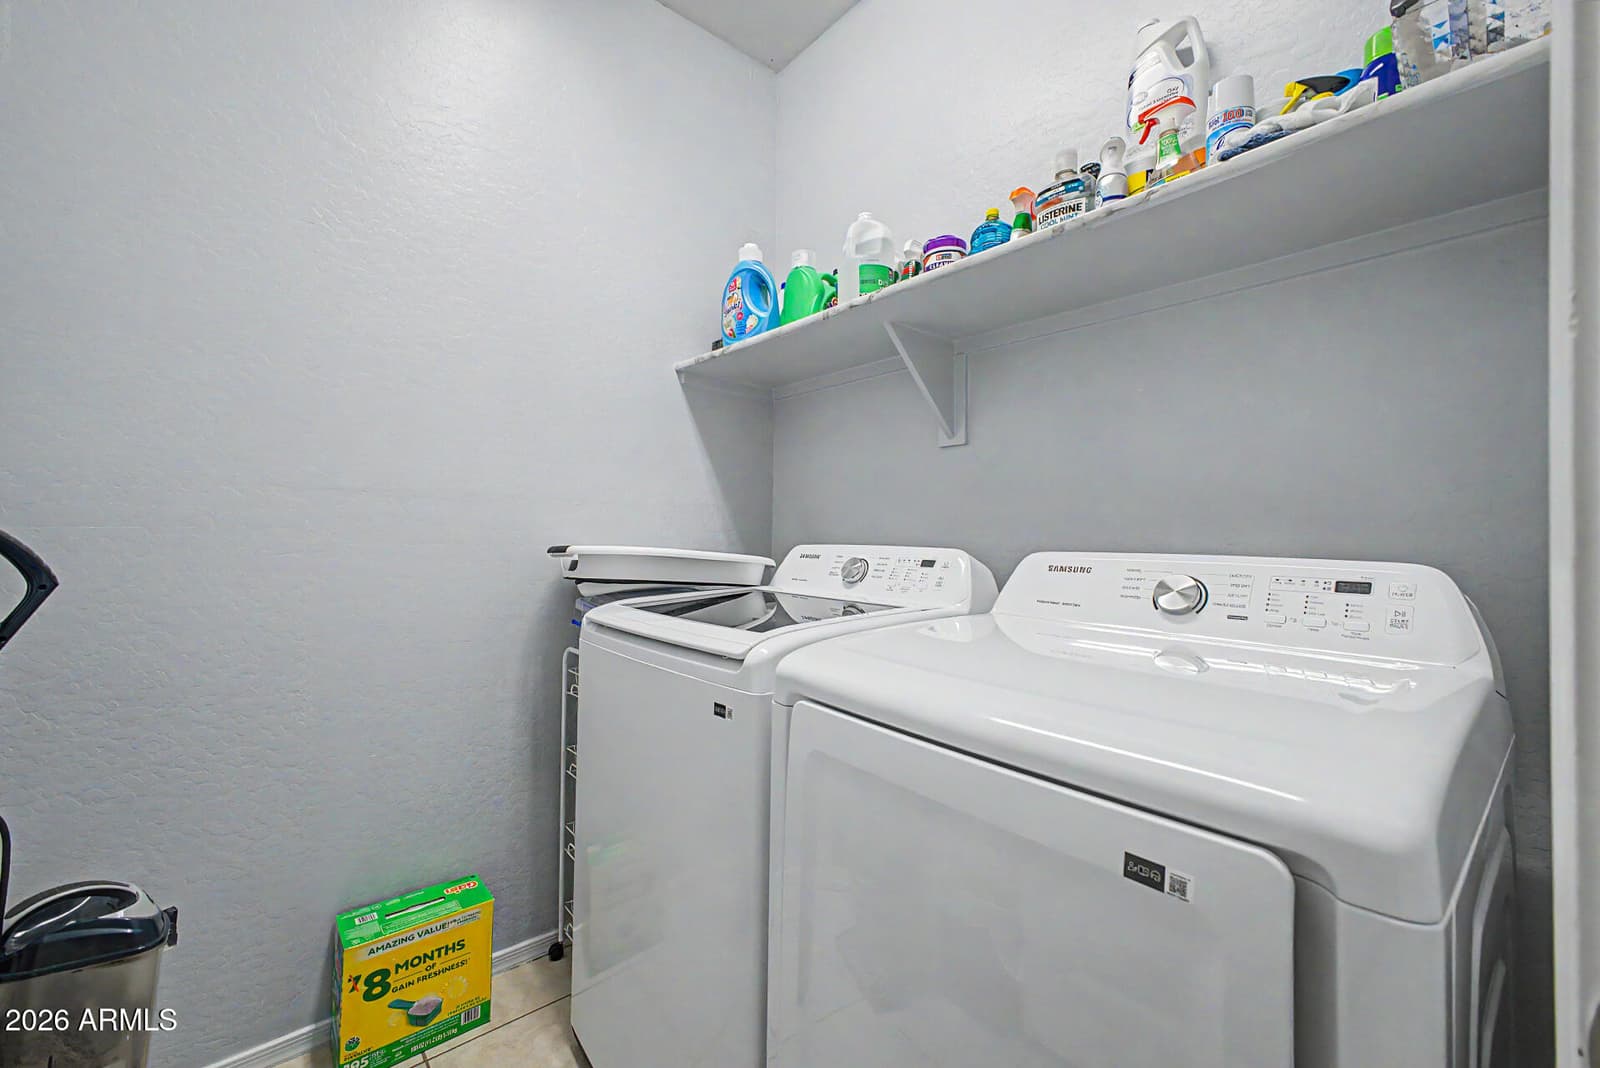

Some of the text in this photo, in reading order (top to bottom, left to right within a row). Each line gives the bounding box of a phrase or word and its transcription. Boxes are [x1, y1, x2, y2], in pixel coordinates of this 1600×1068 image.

[1038, 202, 1083, 226] LISTERINE
[1040, 212, 1079, 230] COOL MINT
[1047, 564, 1093, 575] SAMSUNG
[367, 921, 450, 956] AMAZING VALUE!
[362, 968, 393, 1002] 8
[394, 938, 466, 975] MONTHS
[424, 961, 438, 972] OF
[391, 979, 415, 994] GAIN
